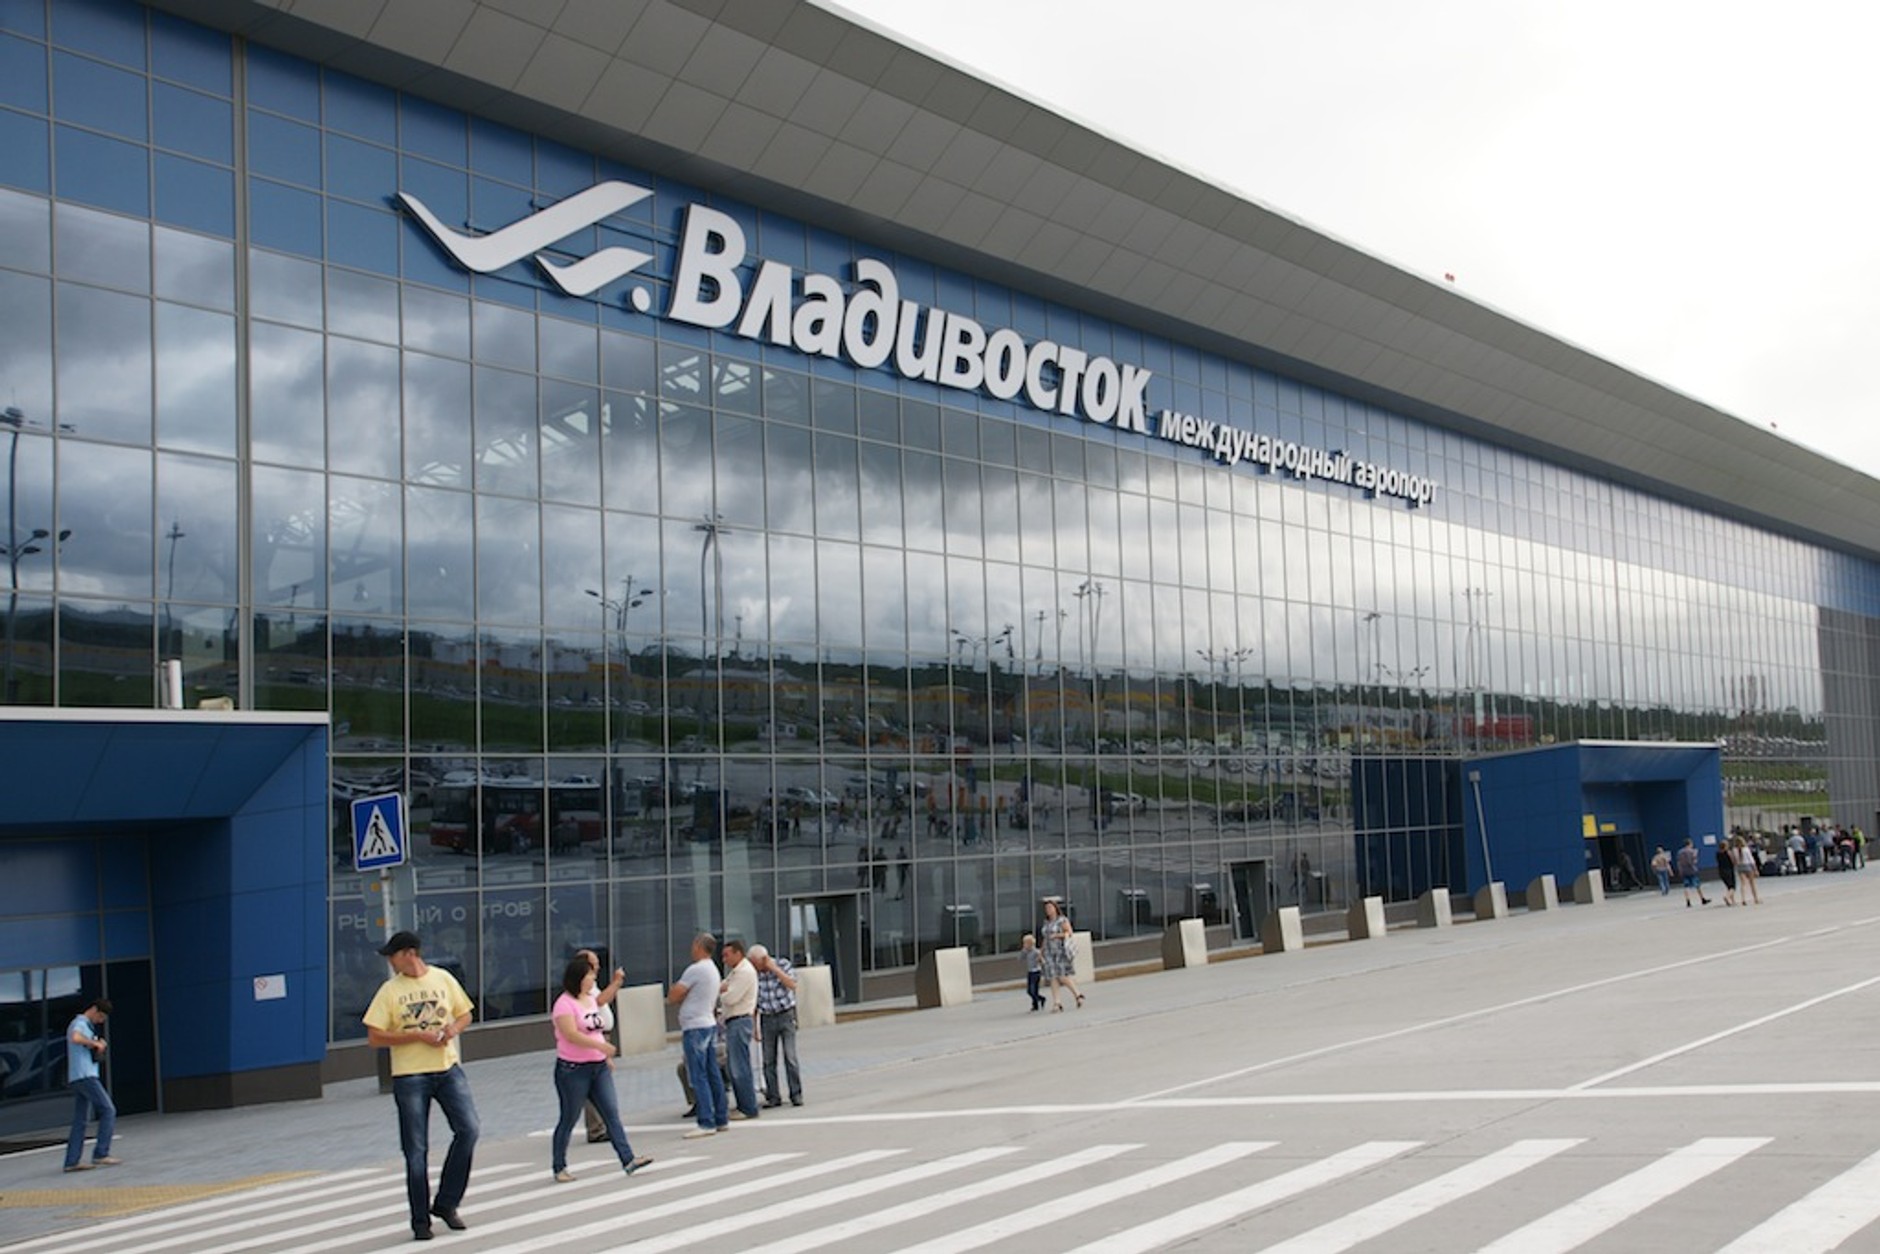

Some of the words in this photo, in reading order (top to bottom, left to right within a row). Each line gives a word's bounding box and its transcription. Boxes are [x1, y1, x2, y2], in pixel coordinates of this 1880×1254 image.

[667, 203, 1152, 434] Владивосток
[1159, 409, 1352, 482] международный
[1355, 460, 1439, 507] аэропорт
[451, 899, 559, 921] ОТРОВК
[399, 989, 446, 1005] DUBAI
